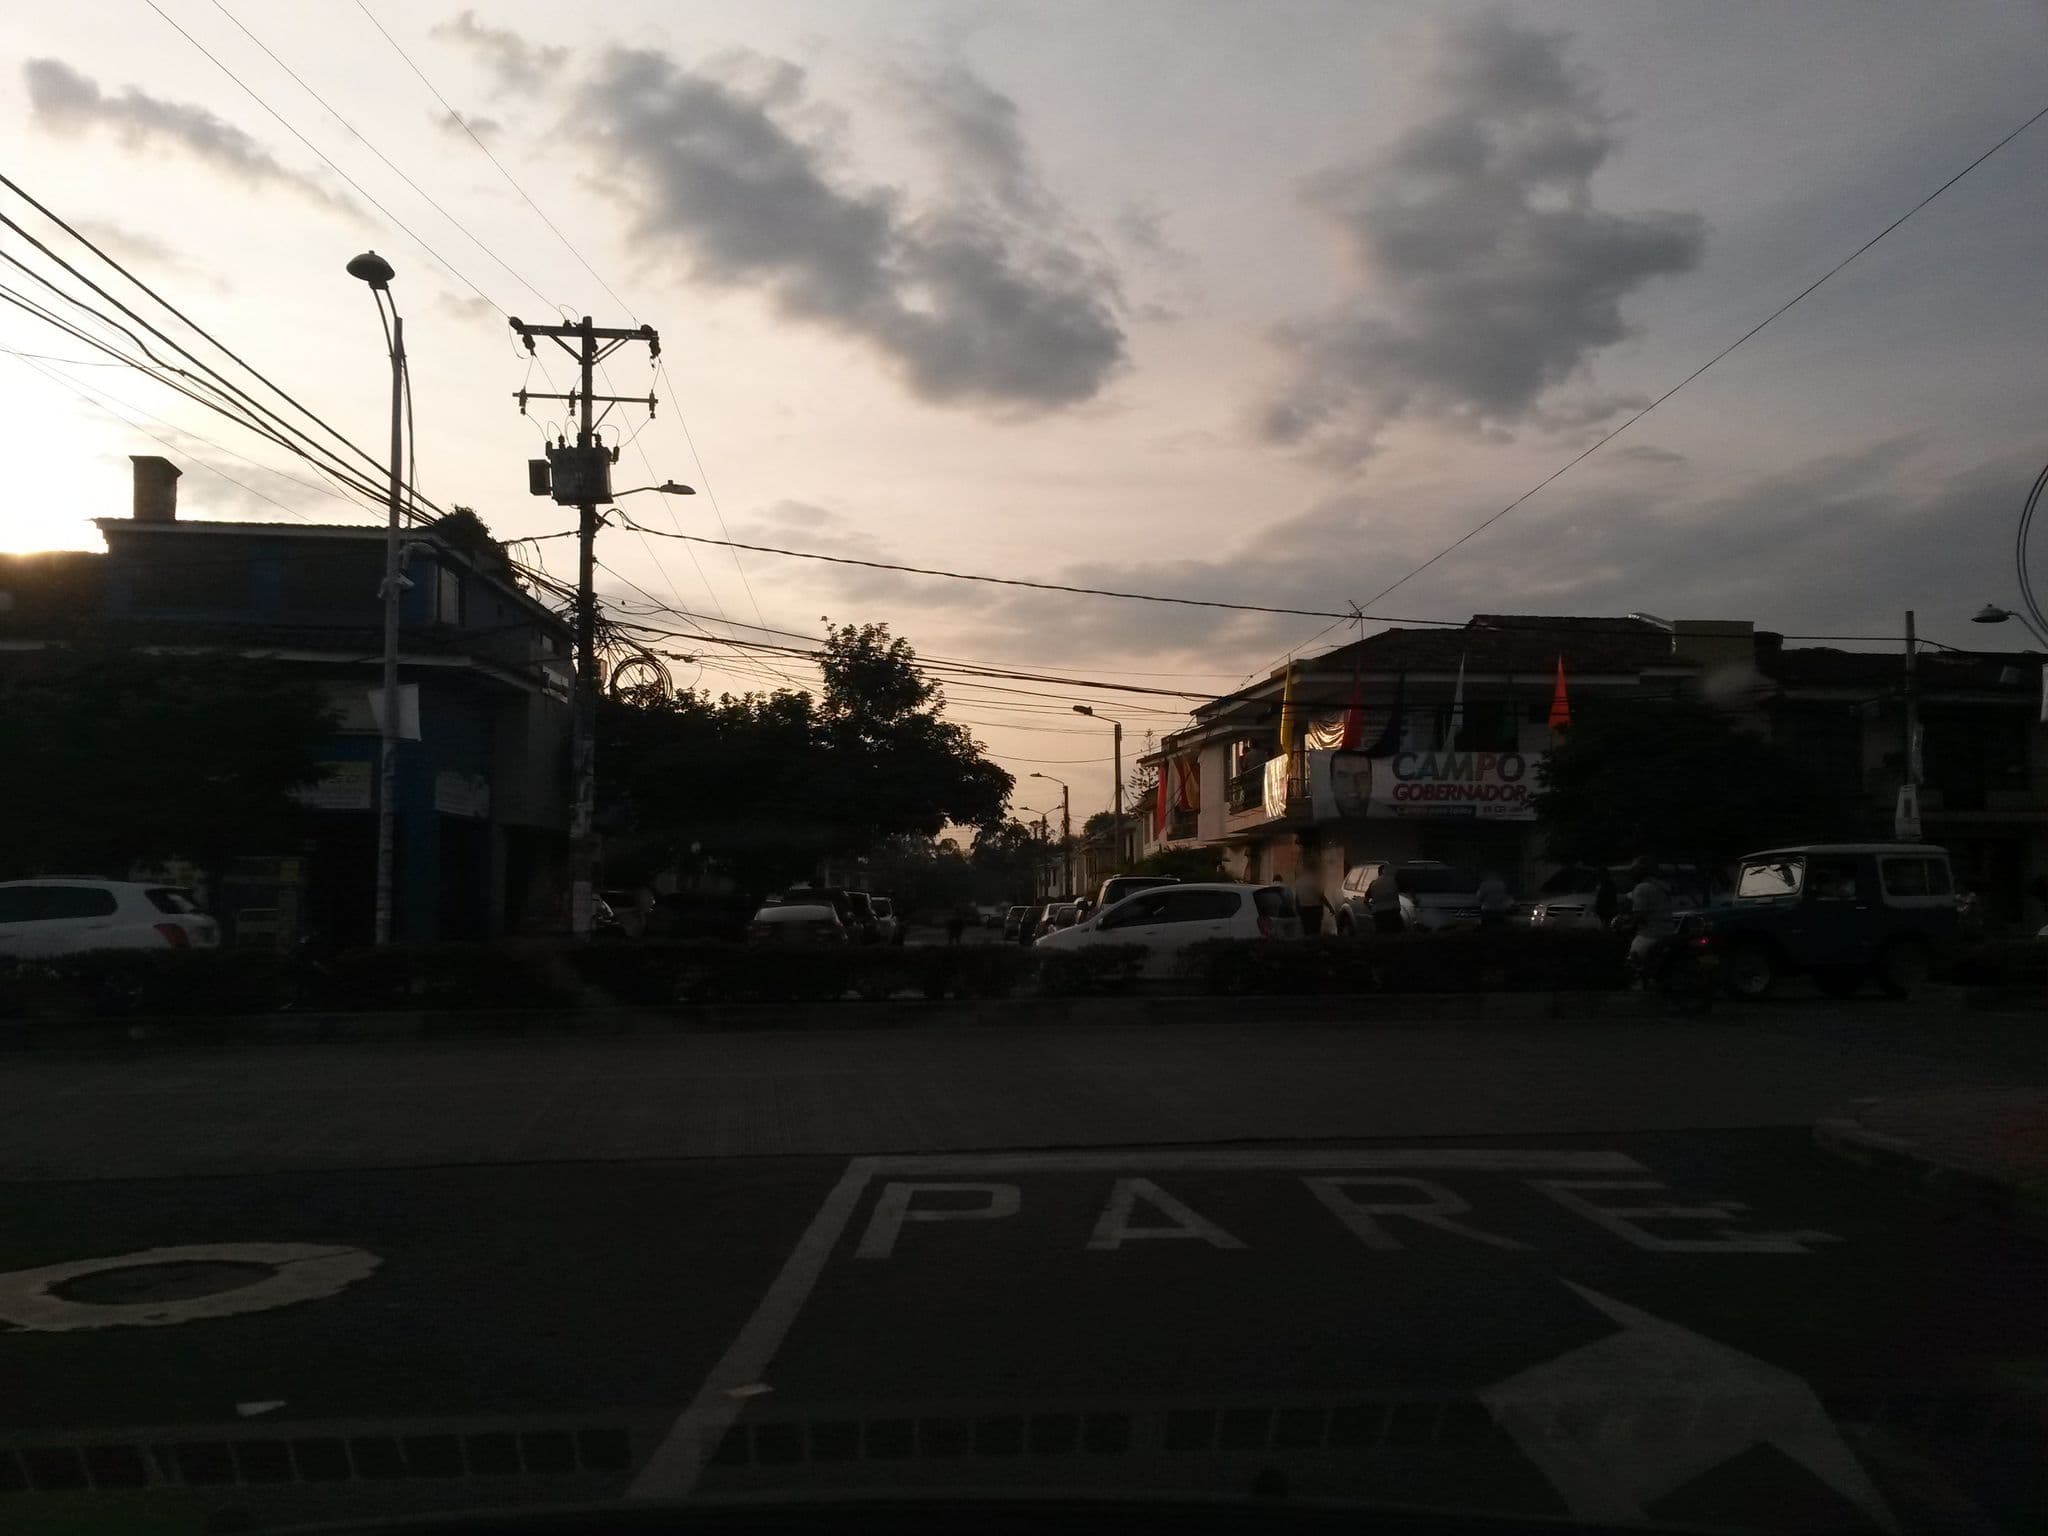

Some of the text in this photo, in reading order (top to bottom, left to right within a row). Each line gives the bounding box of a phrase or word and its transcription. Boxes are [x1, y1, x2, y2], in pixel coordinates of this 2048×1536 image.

[1392, 752, 1525, 782] CAMPO
[1393, 784, 1528, 802] GOBERNADOR
[854, 1177, 1838, 1259] PARE
